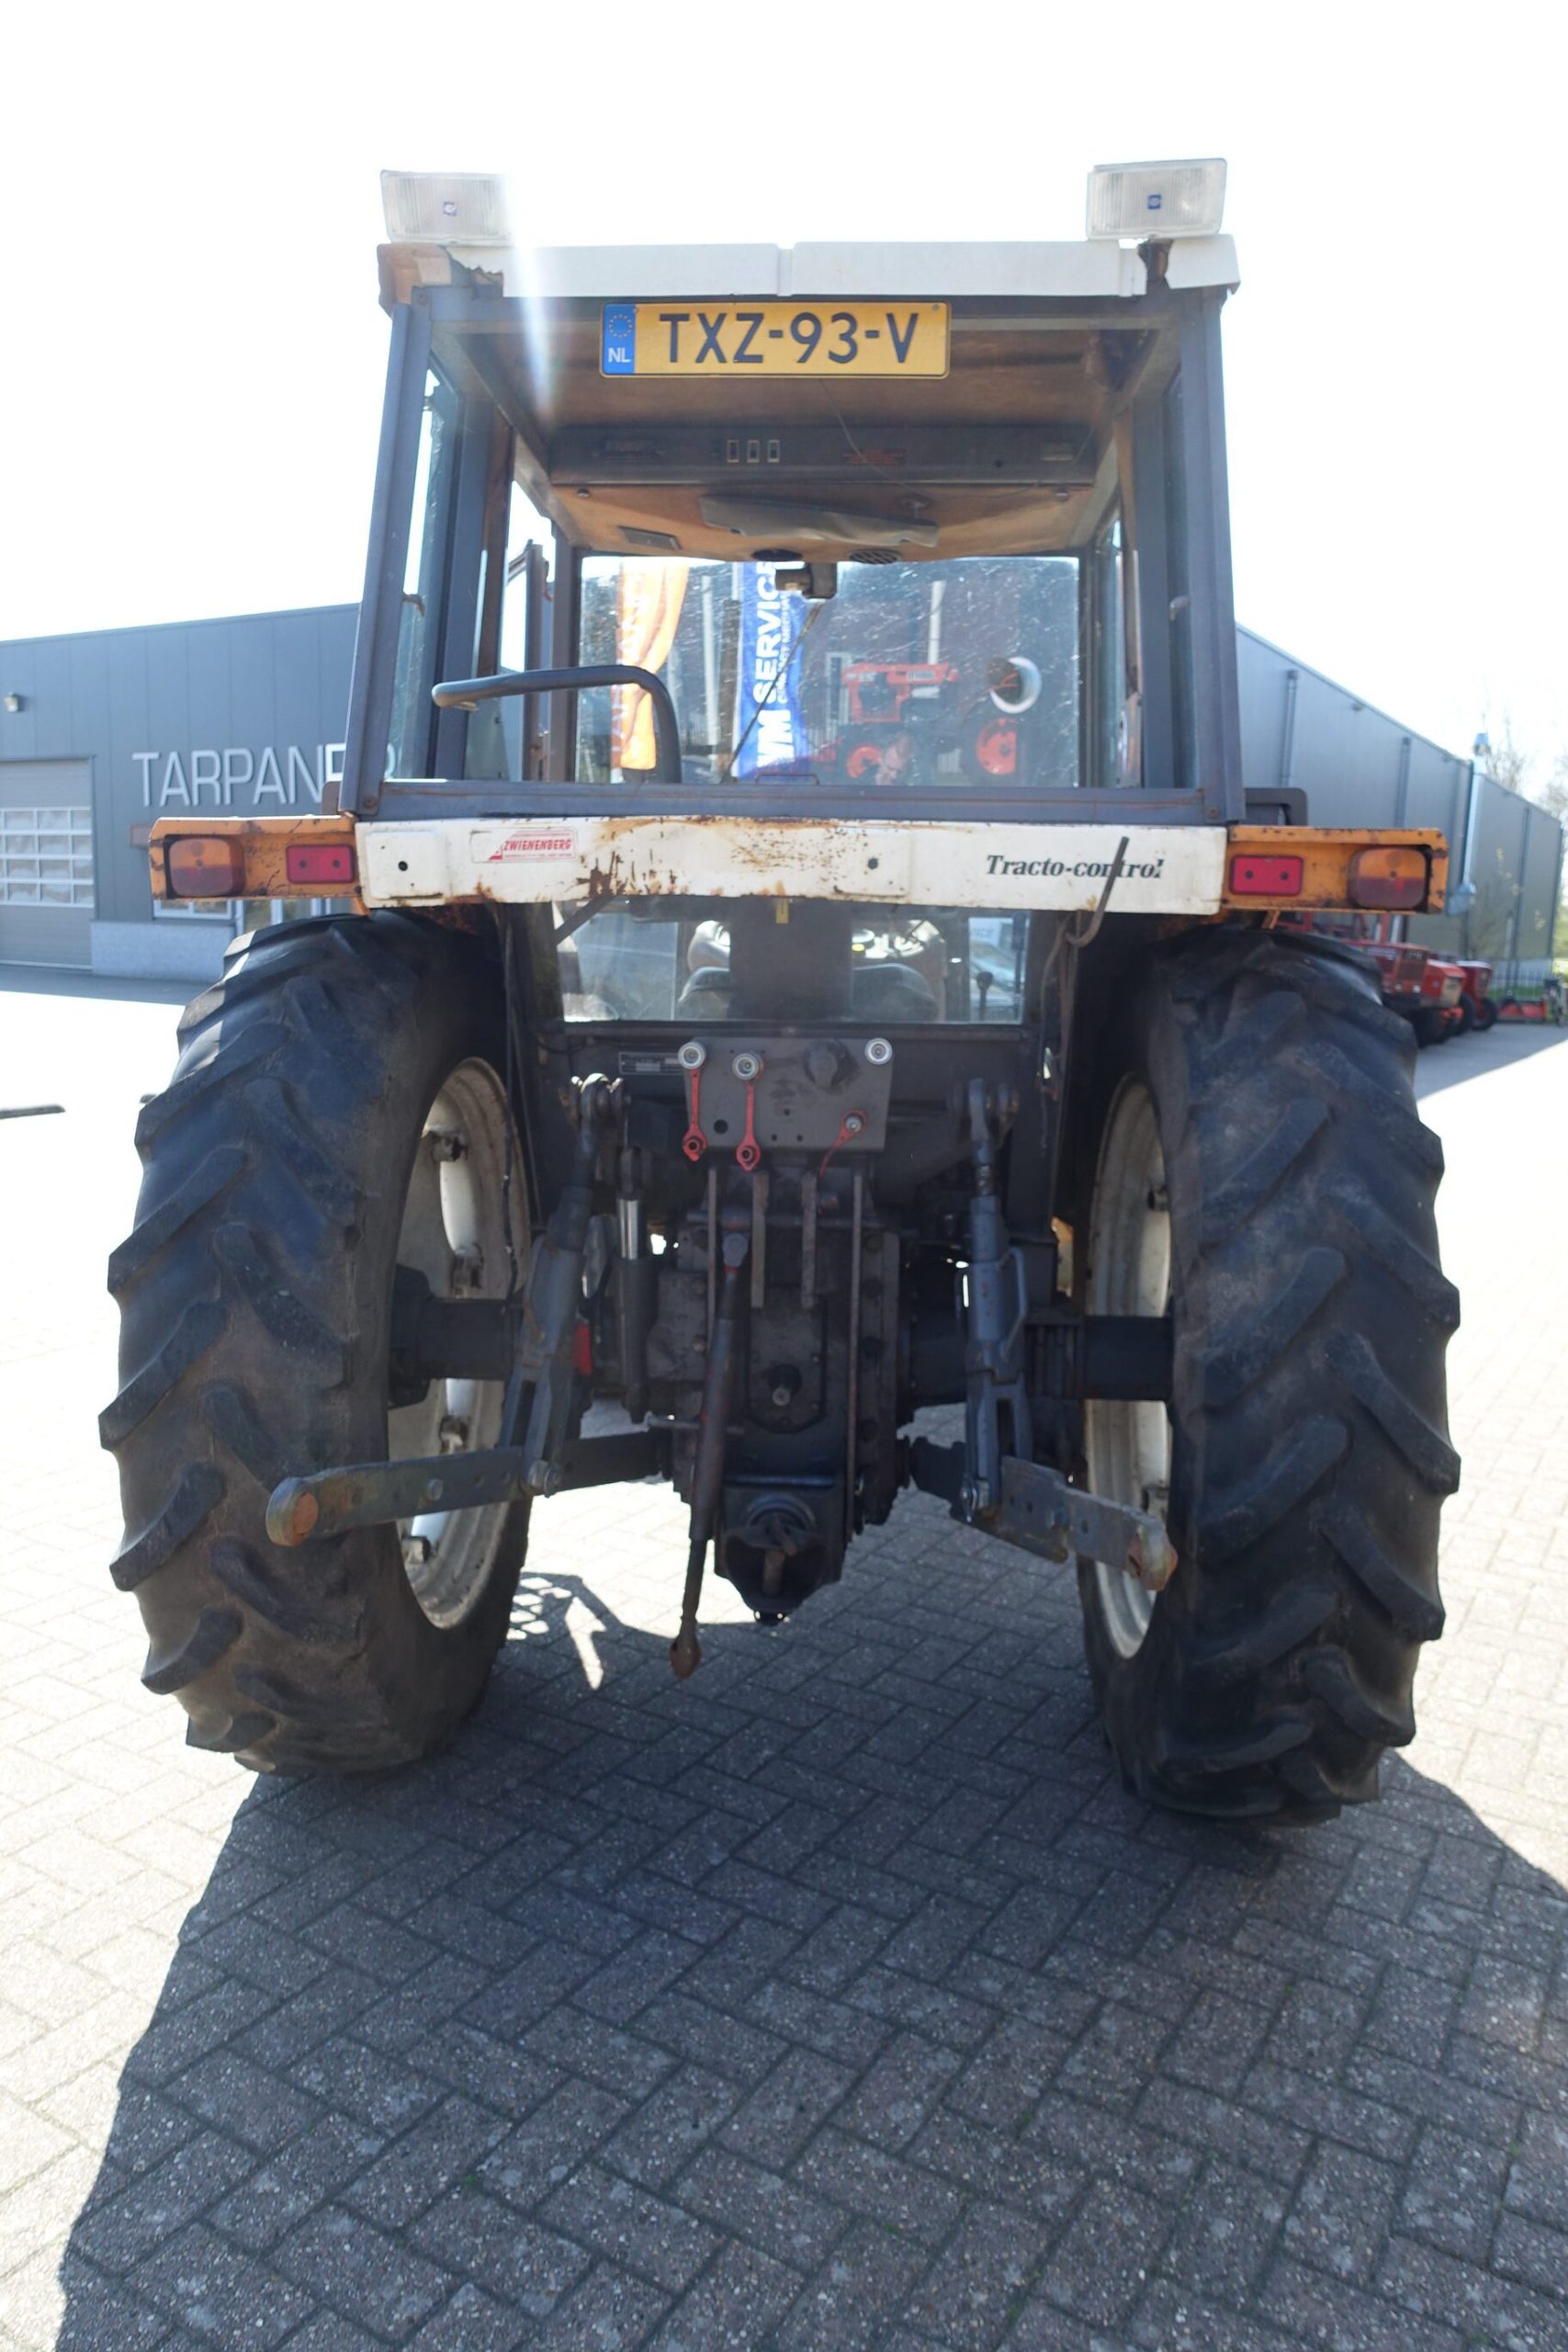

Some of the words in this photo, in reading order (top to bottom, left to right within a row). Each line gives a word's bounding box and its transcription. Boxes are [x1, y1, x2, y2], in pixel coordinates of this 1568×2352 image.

[659, 312, 919, 364] TXZ-93-V
[608, 347, 632, 363] NL
[502, 839, 571, 852] ZWIENENBERG
